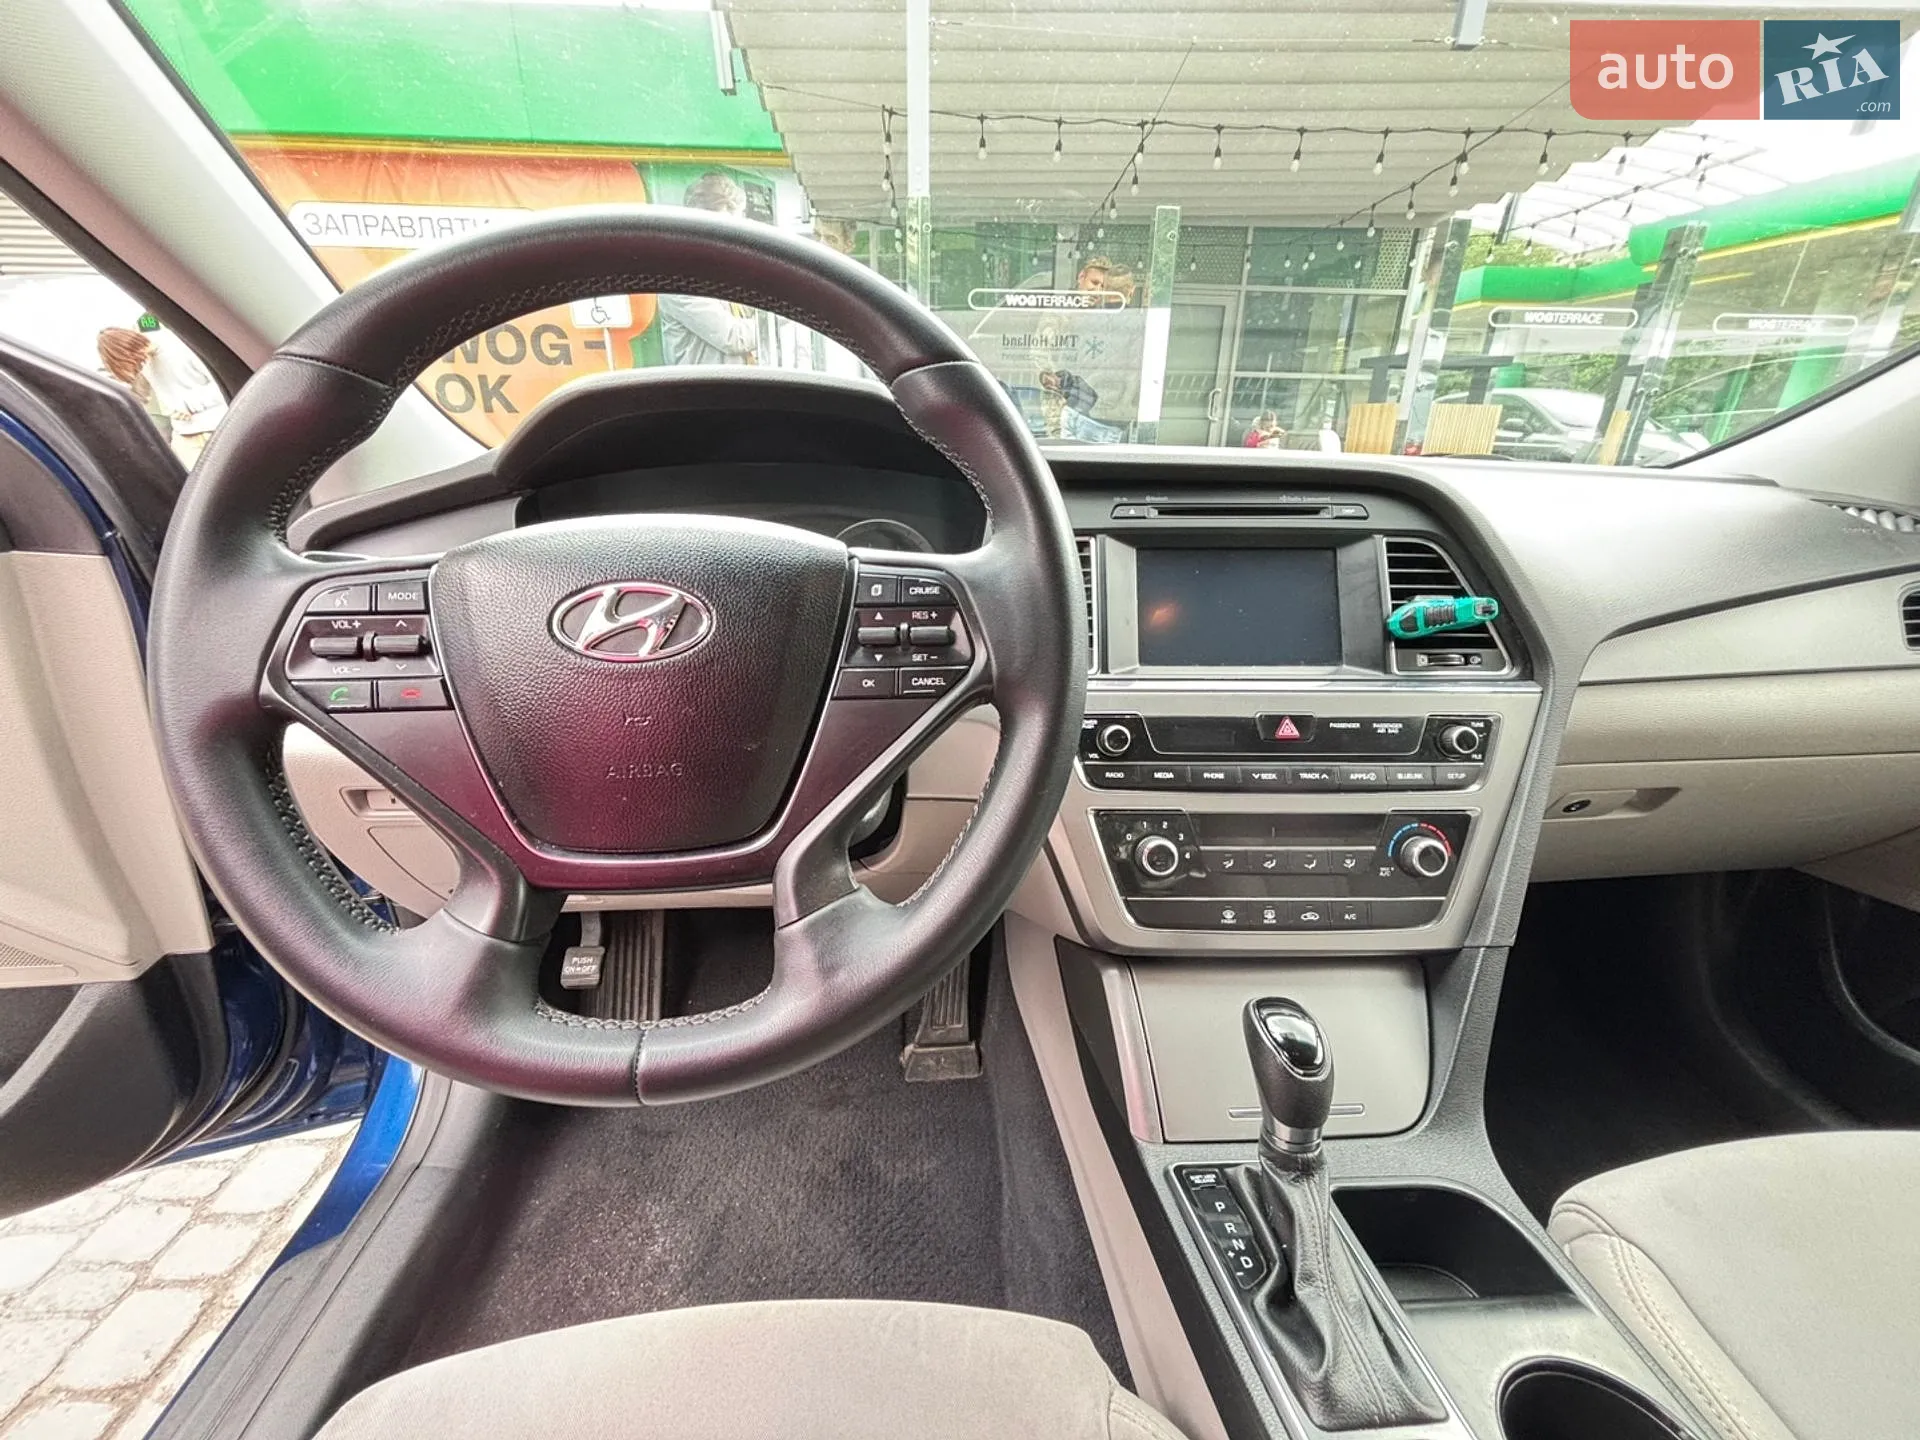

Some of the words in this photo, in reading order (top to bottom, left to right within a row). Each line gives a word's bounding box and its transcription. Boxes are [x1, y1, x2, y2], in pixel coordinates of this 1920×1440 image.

[303, 212, 488, 239] ЗАПРАВЛЯТ
[1005, 294, 1089, 308] WOGTERRACE
[435, 373, 519, 414] OK
[909, 586, 941, 595] CRUISE
[387, 592, 418, 601] MODE
[912, 610, 929, 620] RES
[912, 653, 928, 662] SET
[862, 679, 876, 688] OK
[911, 678, 946, 686] CANCEL
[1203, 772, 1225, 780] PHONE
[1162, 821, 1168, 829] 2
[1178, 833, 1184, 841] 3
[1185, 852, 1191, 860] 4
[1215, 1201, 1226, 1212] P
[1224, 1222, 1237, 1234] R
[1232, 1239, 1246, 1250] N
[1240, 1256, 1254, 1269] D
